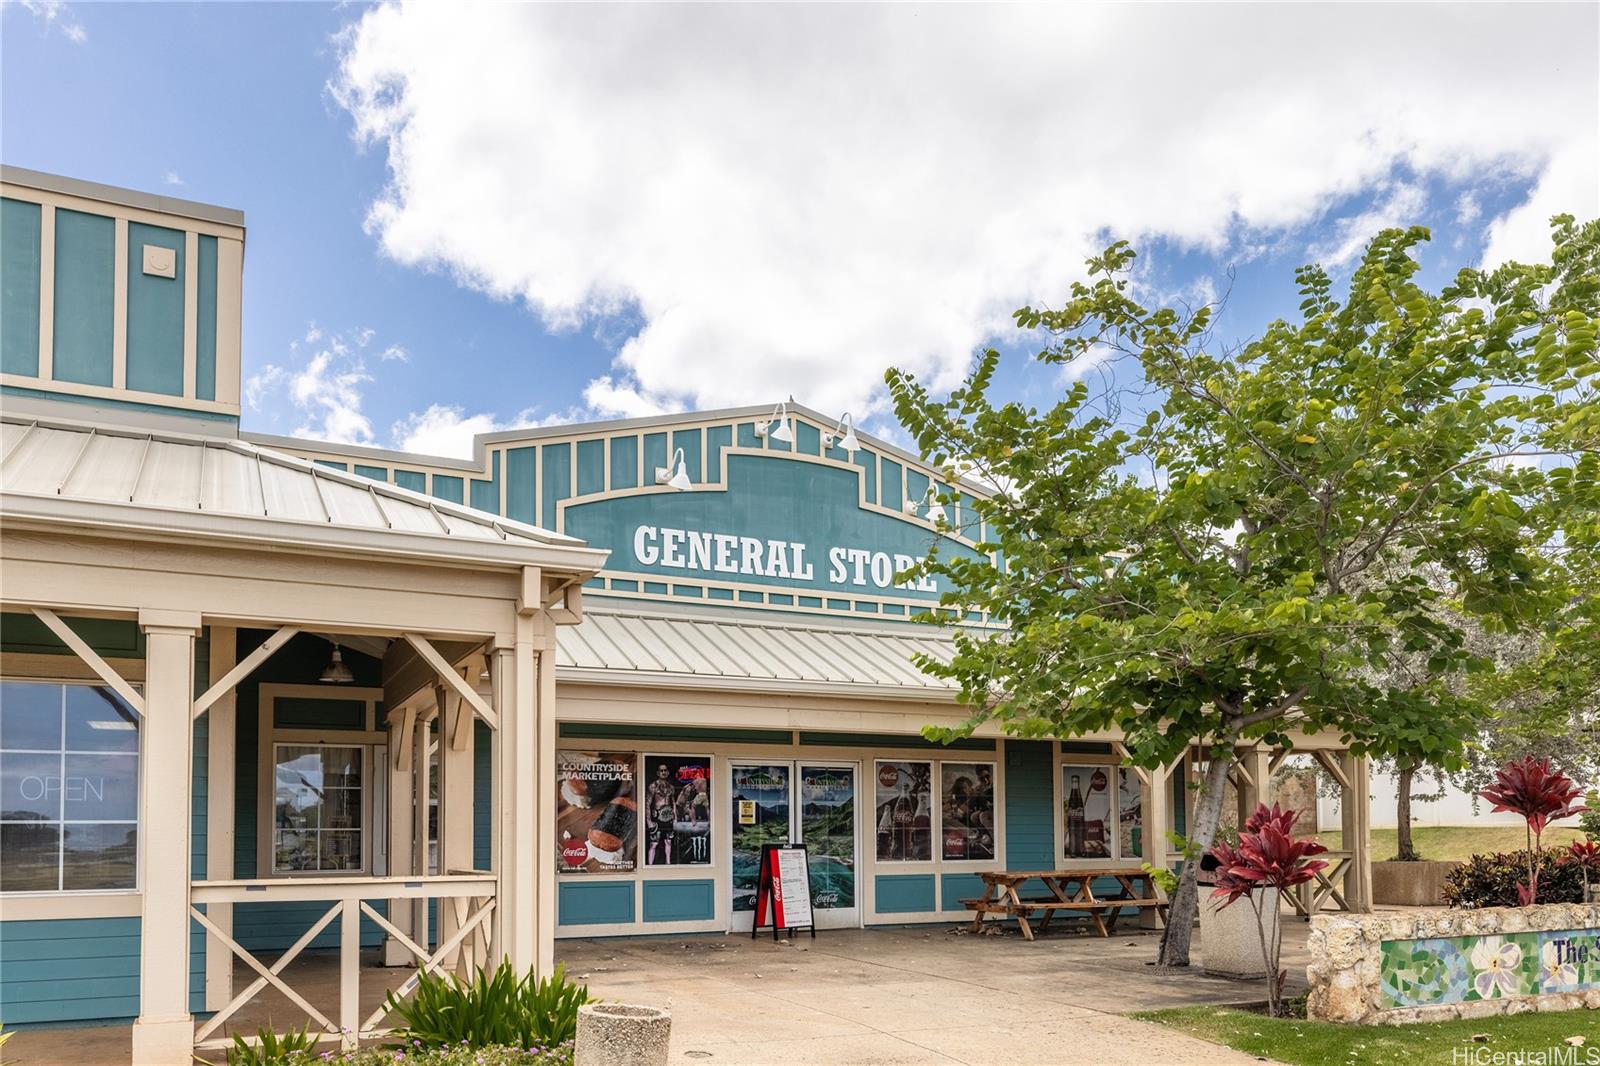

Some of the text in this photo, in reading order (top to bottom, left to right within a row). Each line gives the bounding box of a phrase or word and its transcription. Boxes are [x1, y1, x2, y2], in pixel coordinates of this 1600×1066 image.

[634, 525, 937, 592] GENERAL STORE
[562, 762, 630, 772] COUNTRYSIDE
[562, 772, 633, 781] MARKETPLACE
[20, 775, 104, 801] OPEN
[1552, 939, 1589, 966] The
